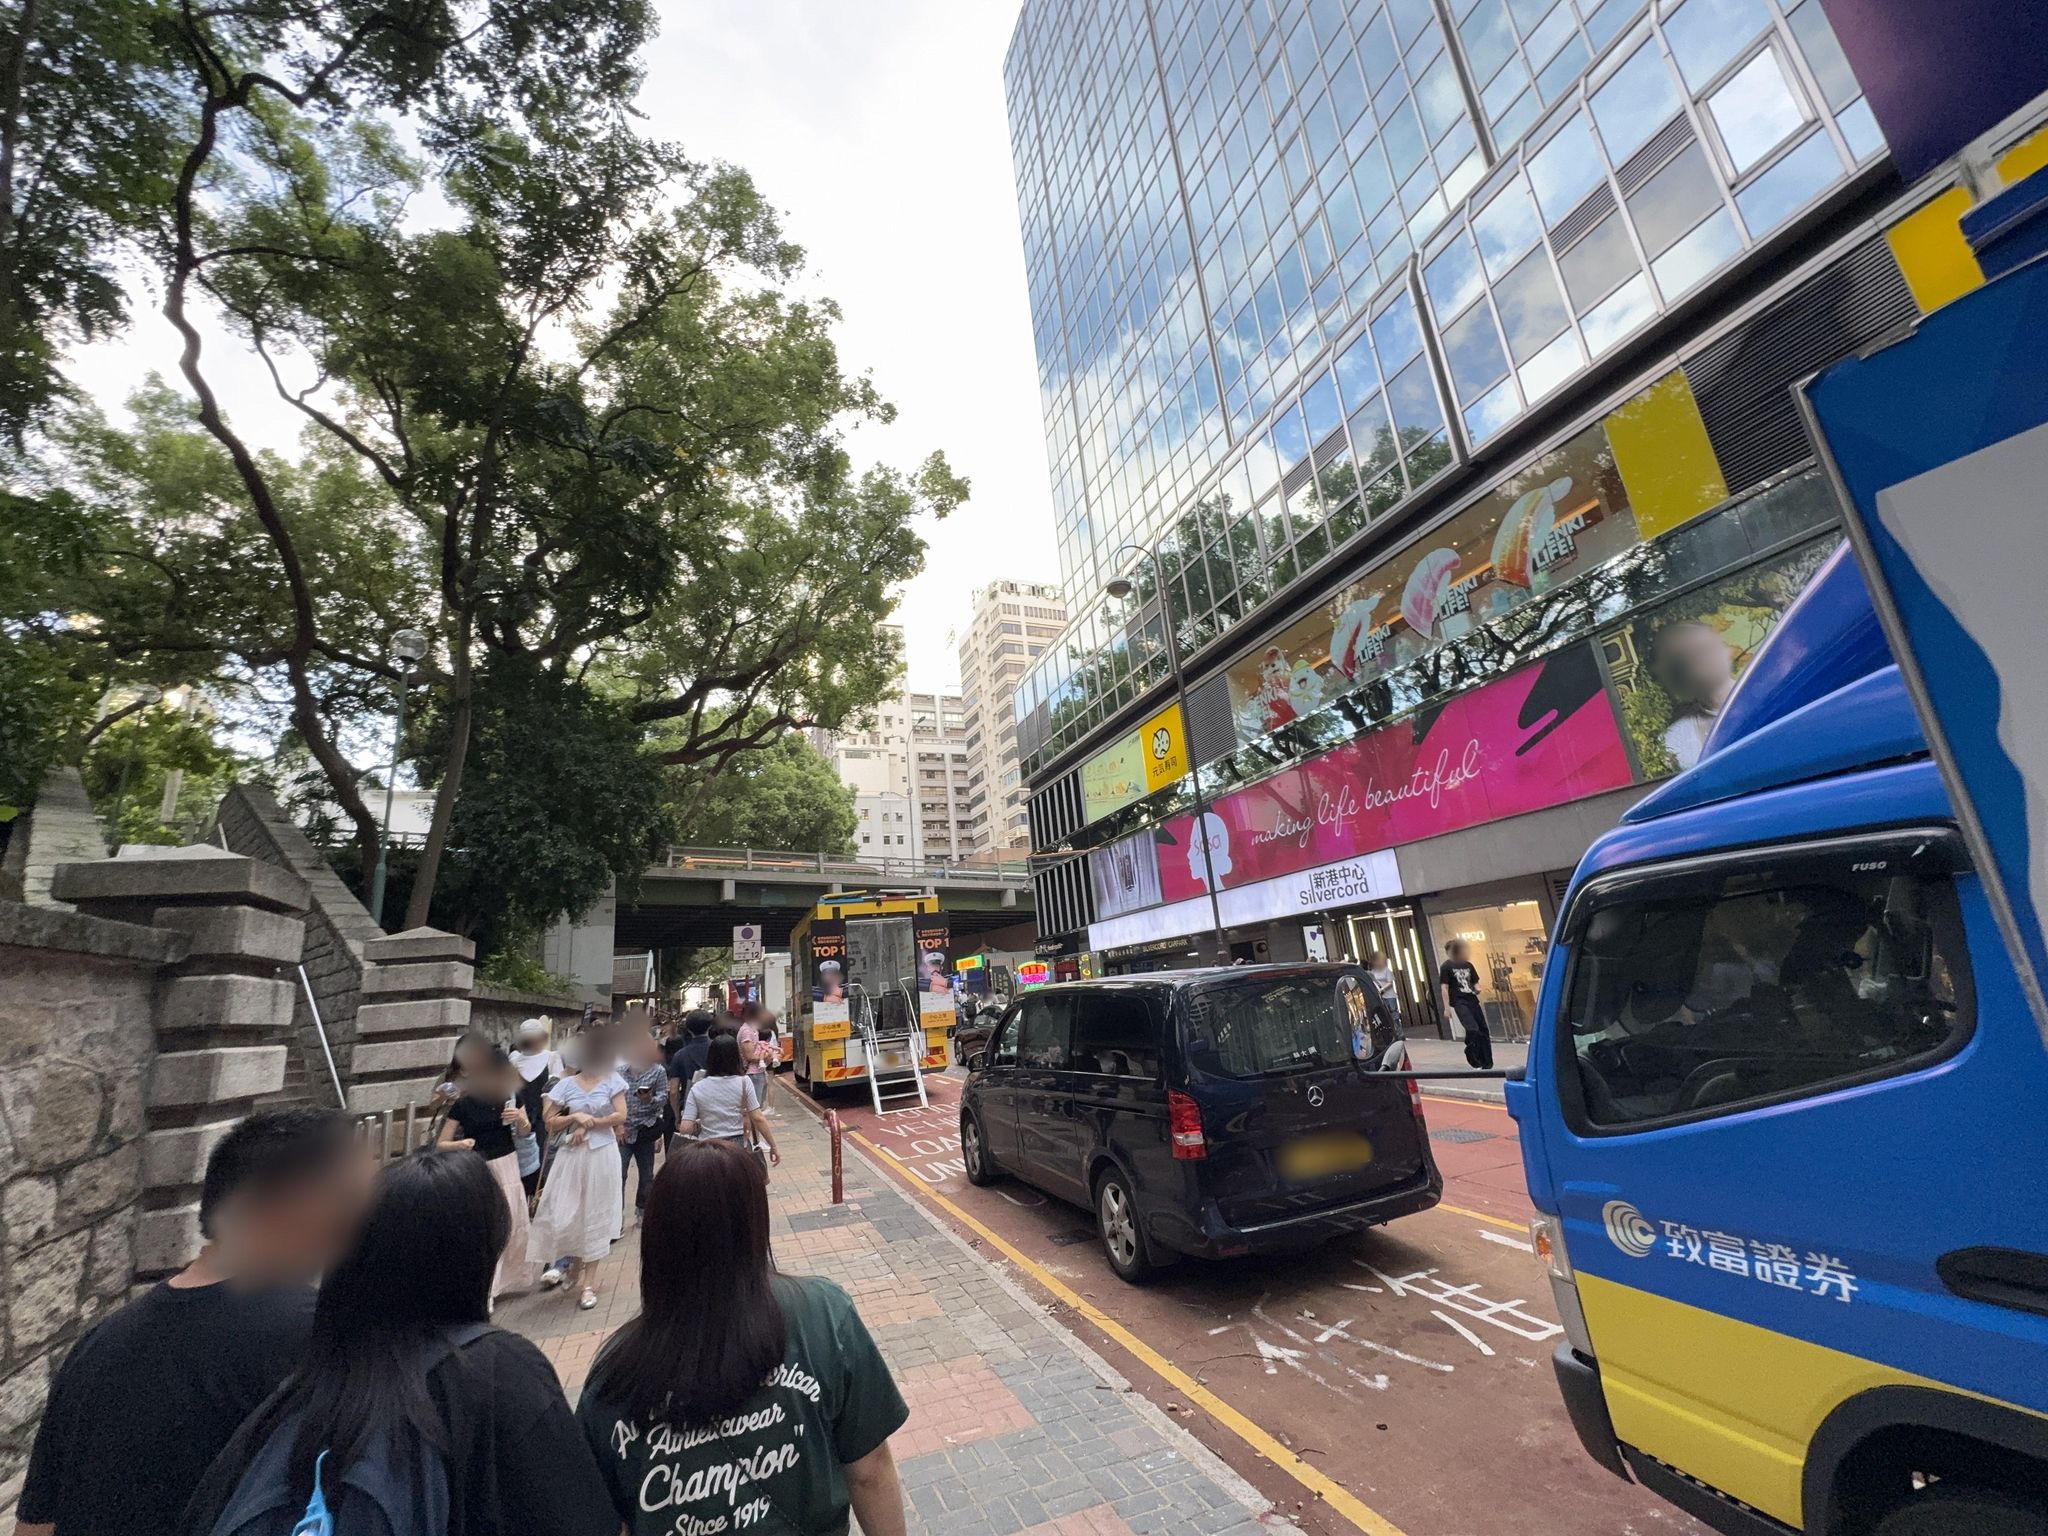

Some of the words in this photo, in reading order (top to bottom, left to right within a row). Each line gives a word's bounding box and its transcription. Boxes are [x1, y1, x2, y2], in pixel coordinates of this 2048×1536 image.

[1533, 535, 1575, 569] LIFE!
[1440, 593, 1470, 621] LIFE!
[1359, 640, 1385, 665] LIFE!
[1251, 810, 1314, 848] making
[1318, 784, 1360, 837] life
[1364, 739, 1481, 809] beautiful
[1312, 863, 1366, 890] 新港中心
[1851, 861, 1888, 872] FUSO
[1299, 873, 1370, 906] Silvercord
[813, 945, 839, 958] TOP
[840, 945, 846, 956] 1
[917, 938, 941, 950] TOP
[943, 937, 950, 948] 1
[1659, 1219, 1859, 1303] 致富證券
[765, 1362, 821, 1403] erican
[732, 1494, 772, 1530] 1919
